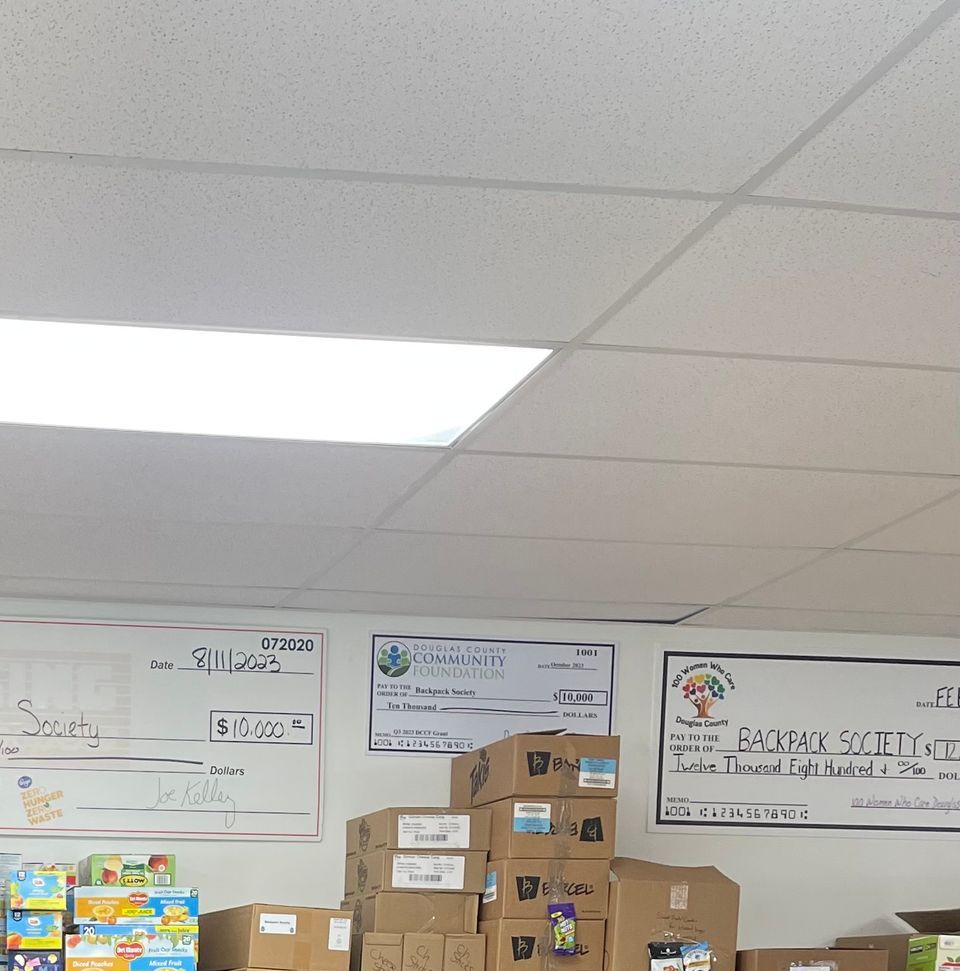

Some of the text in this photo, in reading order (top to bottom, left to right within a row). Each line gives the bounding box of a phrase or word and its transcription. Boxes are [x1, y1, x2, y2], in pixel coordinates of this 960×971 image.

[261, 637, 315, 652] 072020
[413, 644, 506, 655] DOUGLAS COUNTY
[413, 653, 507, 667] COMMUNITY
[576, 649, 598, 657] 1001
[150, 647, 281, 675] Date 8/11/2023
[413, 665, 505, 680] FOUNDATION
[671, 661, 736, 691] 100 Women Who Care
[415, 687, 476, 697] Backpack Society
[562, 692, 594, 703] 10,000
[387, 701, 437, 711] Ten Thousand
[17, 699, 100, 748] Society
[217, 718, 228, 735] $
[676, 716, 728, 728] Douglas County
[670, 733, 720, 742] PAY TO THE
[739, 727, 924, 756] BACKPACK SOCIETY
[670, 744, 715, 753] ORDER OF
[209, 766, 245, 776] Dollars
[672, 753, 874, 781] Twelve Thousand Eight Hundred
[28, 808, 64, 826] WASTE
